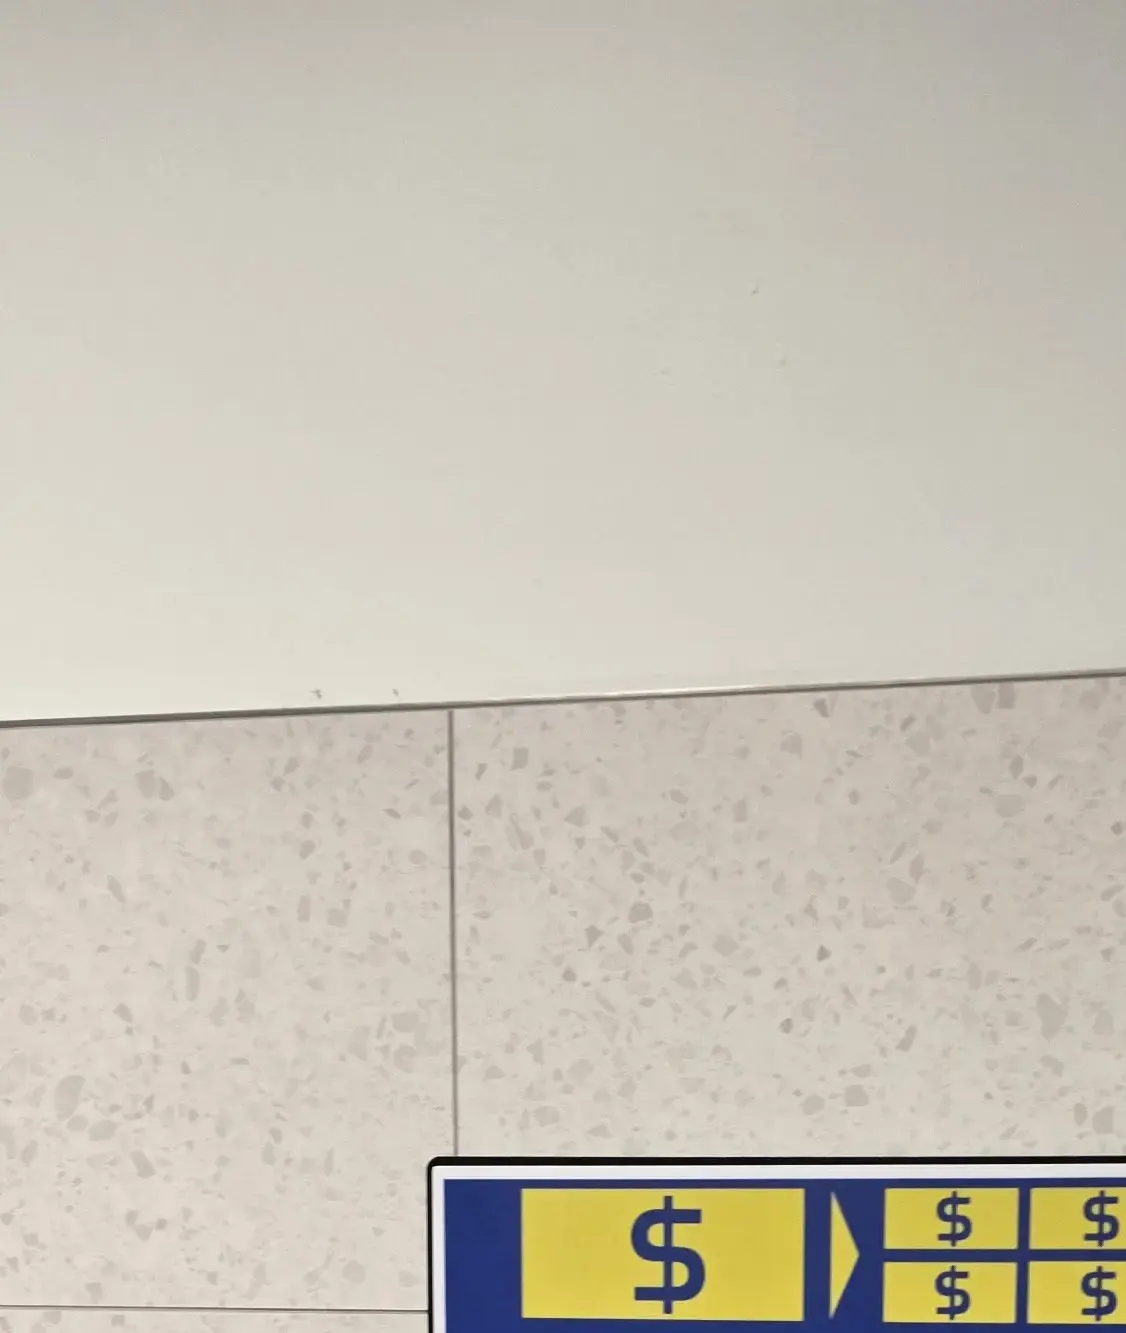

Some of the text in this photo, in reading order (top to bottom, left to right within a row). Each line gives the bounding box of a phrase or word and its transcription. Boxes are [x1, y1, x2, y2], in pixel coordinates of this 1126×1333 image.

[936, 1190, 1121, 1247] $ $
[630, 1195, 706, 1315] $
[935, 1265, 1118, 1321] $ $
